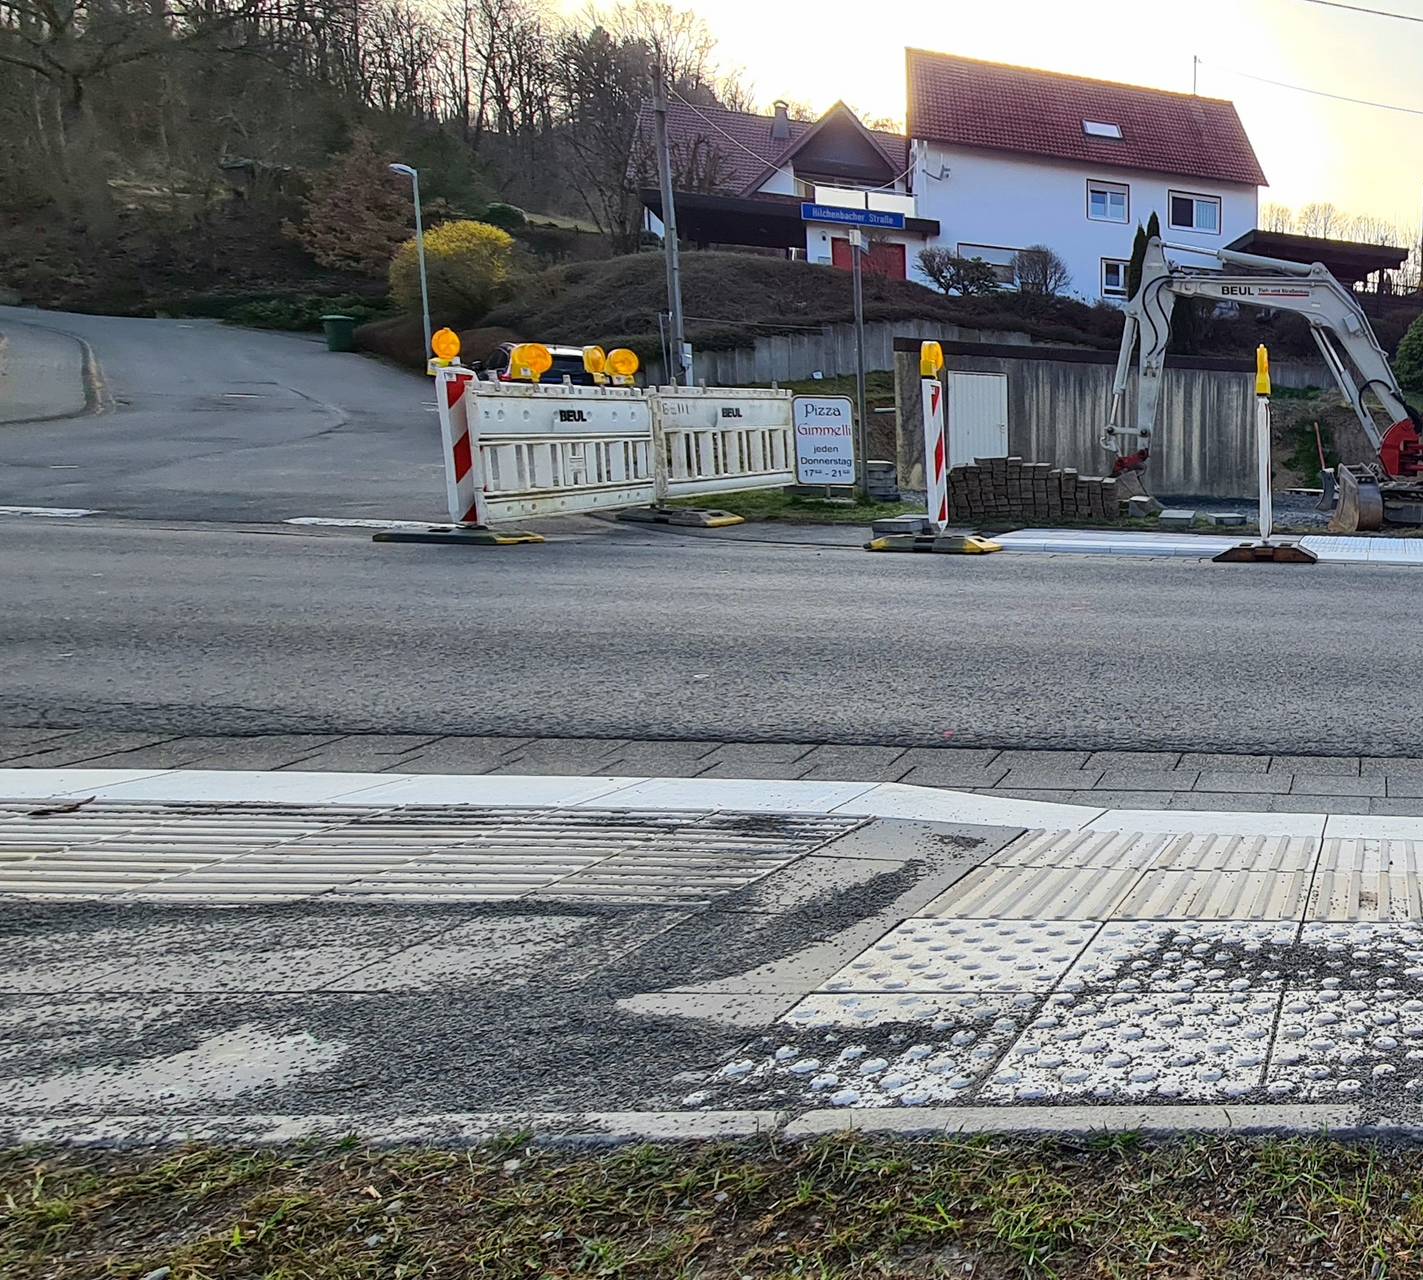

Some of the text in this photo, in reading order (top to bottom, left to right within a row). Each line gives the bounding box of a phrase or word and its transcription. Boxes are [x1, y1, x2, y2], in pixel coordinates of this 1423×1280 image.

[869, 213, 894, 225] Straße
[1221, 286, 1254, 296] BEUL
[559, 409, 587, 422] BEUL
[721, 407, 742, 418] BEUL
[804, 403, 842, 417] Pizza
[797, 423, 851, 436] Gimmelli
[814, 445, 839, 454] jeden
[801, 456, 852, 467] Donnerstag
